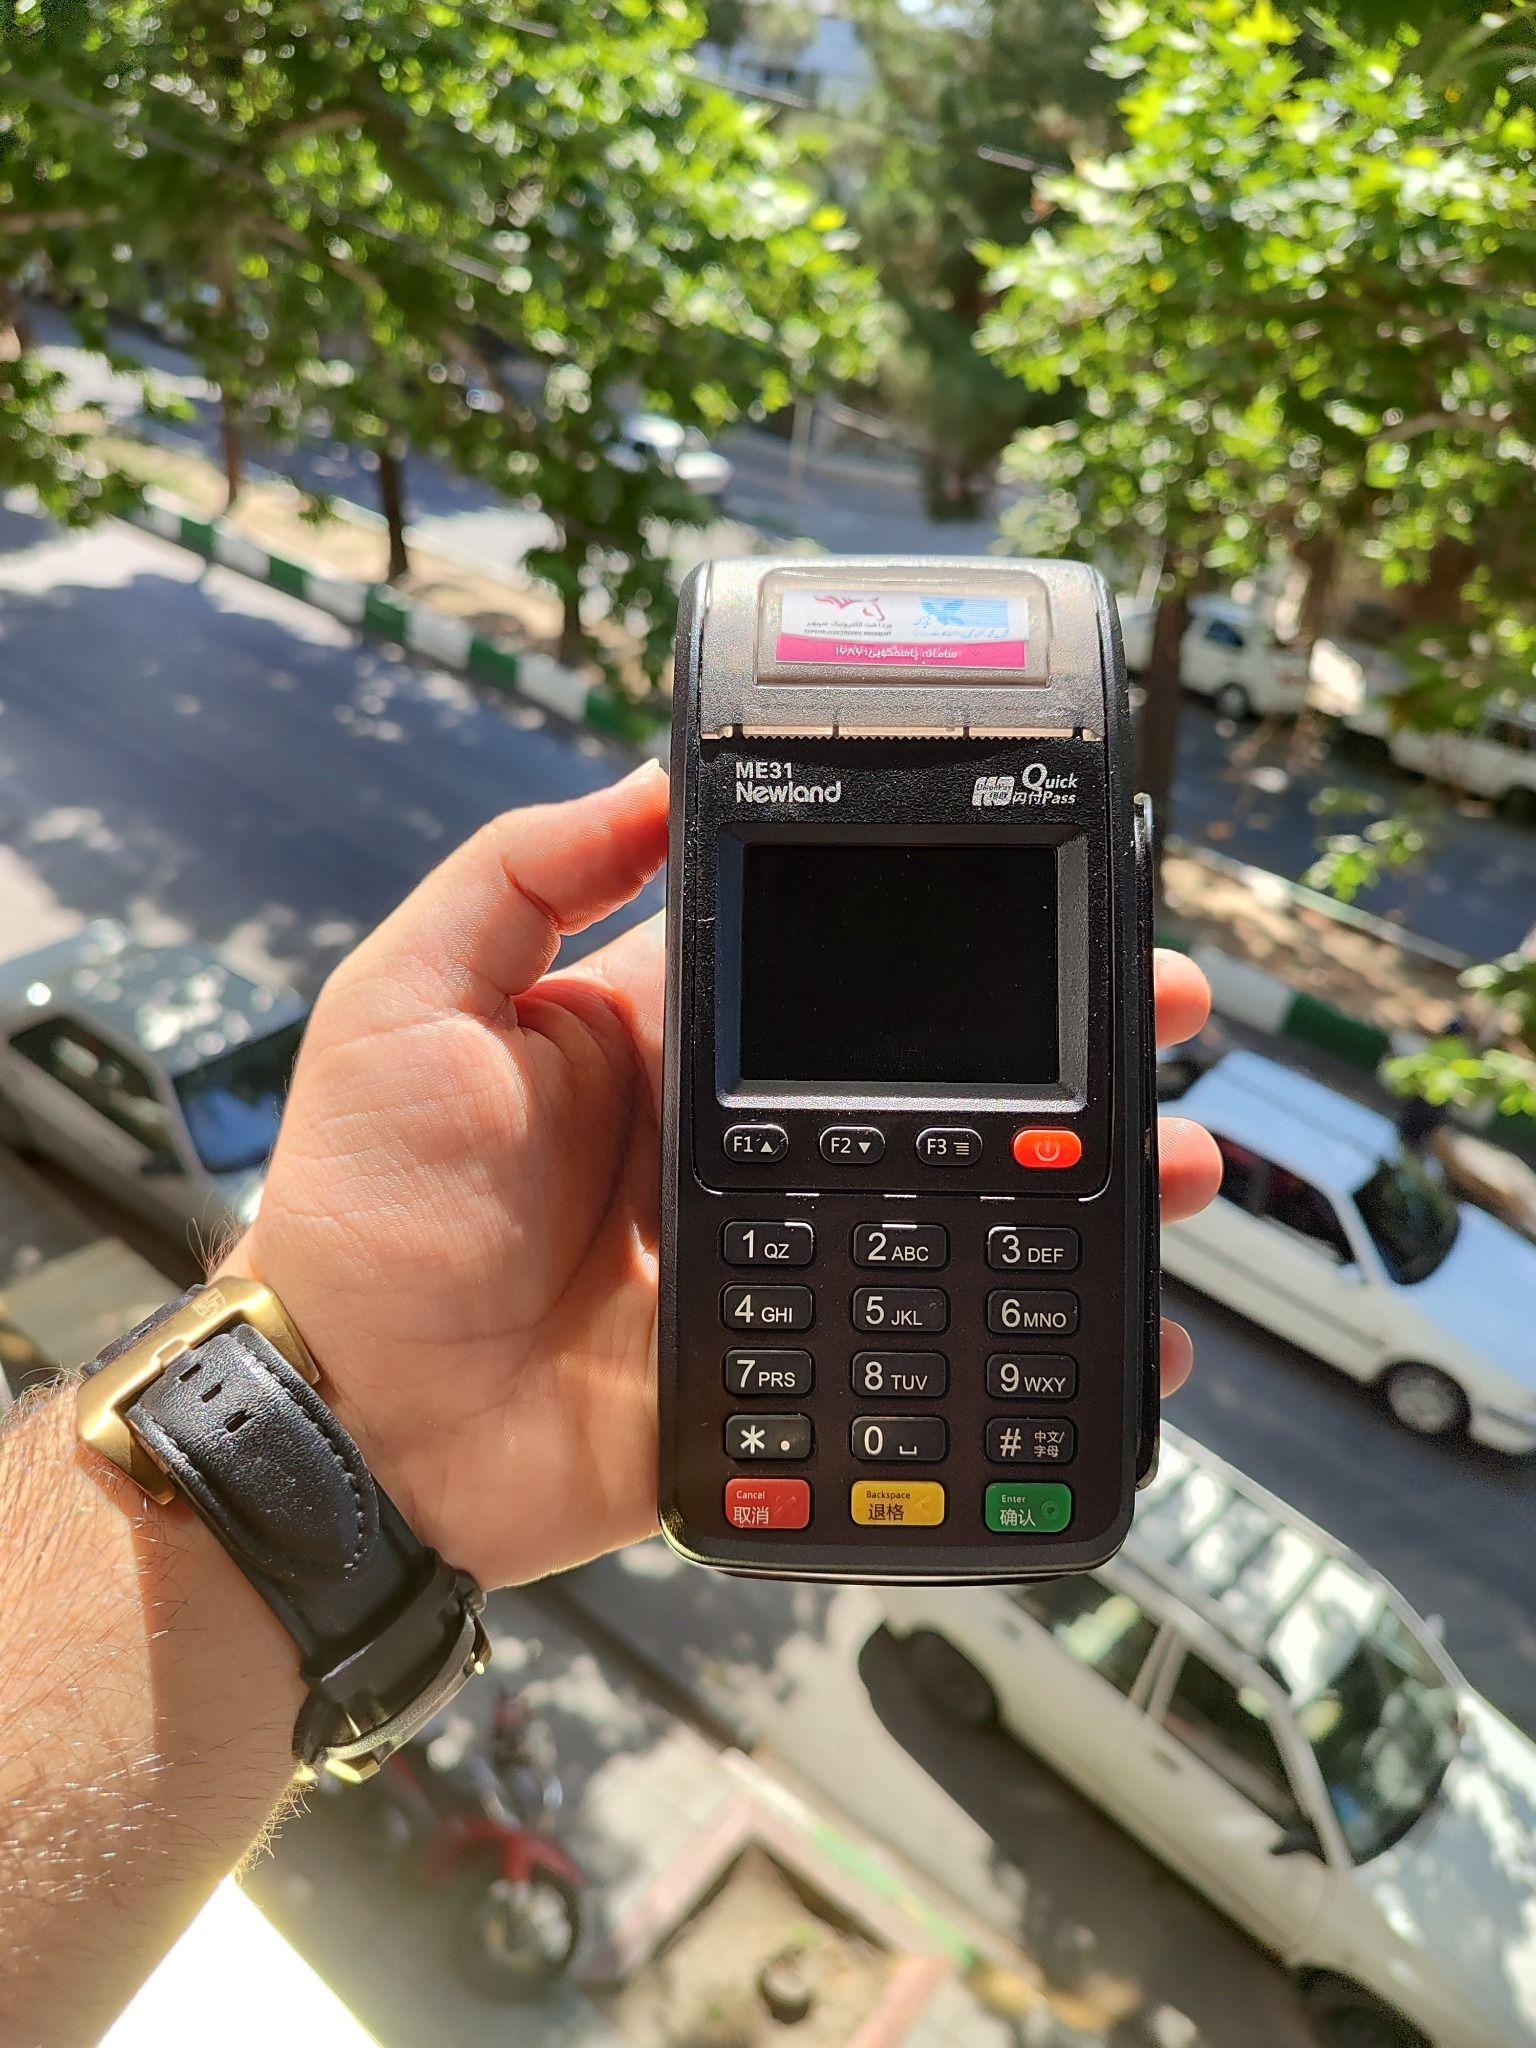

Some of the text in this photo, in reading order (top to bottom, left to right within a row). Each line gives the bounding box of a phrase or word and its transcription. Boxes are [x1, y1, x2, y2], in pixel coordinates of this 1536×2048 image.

[736, 761, 792, 779] ME31
[1022, 763, 1079, 789] Quick
[736, 780, 842, 803] Newland
[733, 1135, 754, 1153] F1
[831, 1137, 851, 1154] F2
[927, 1138, 947, 1155] F3
[742, 1229, 790, 1260] 1 QZ
[867, 1232, 929, 1262] 2 ABC
[1001, 1234, 1064, 1264] 3 DEF
[734, 1294, 793, 1323] 4 GHI
[865, 1296, 923, 1326] 5 JKL
[1001, 1298, 1067, 1328] 6 MNO
[736, 1359, 796, 1388] 7 PRS
[864, 1361, 928, 1391] 8 TUV
[1000, 1363, 1066, 1393] 9 WXY
[864, 1425, 884, 1455] 0
[999, 1427, 1022, 1457] #
[1034, 1430, 1065, 1444] 中文/
[1033, 1444, 1060, 1458] 字母
[736, 1490, 766, 1500] Cancel
[866, 1490, 911, 1501] Backspace
[1001, 1494, 1027, 1504] Enter
[733, 1506, 769, 1526] 取消
[867, 1503, 904, 1522] 退格
[999, 1507, 1036, 1527] 确认
